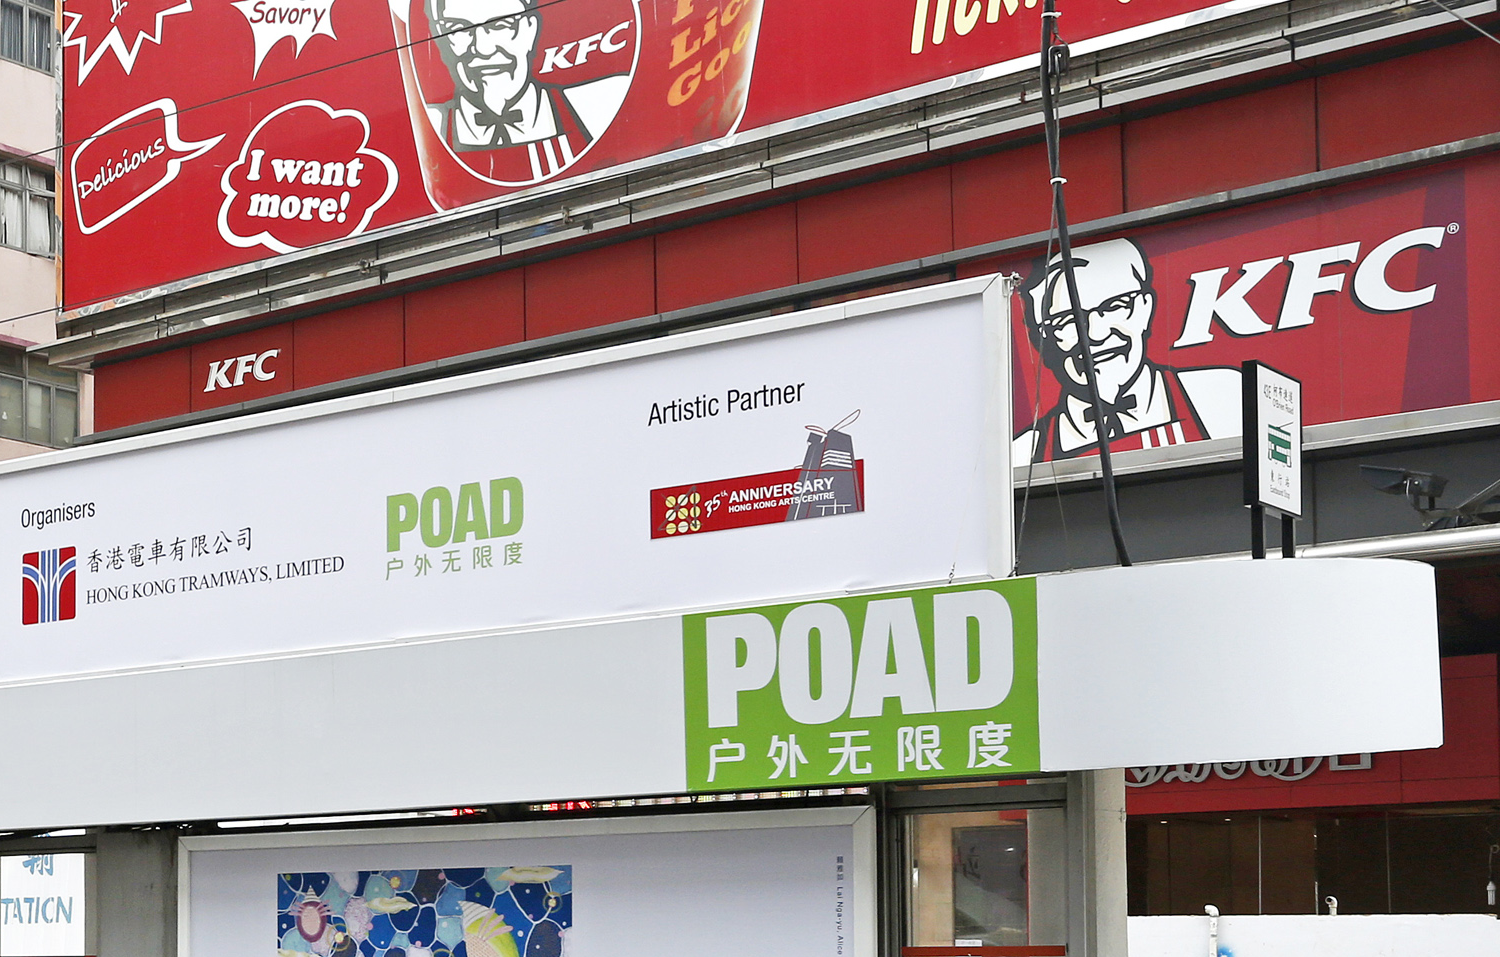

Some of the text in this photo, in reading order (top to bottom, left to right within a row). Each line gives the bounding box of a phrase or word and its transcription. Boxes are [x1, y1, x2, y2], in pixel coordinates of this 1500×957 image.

[250, 1, 327, 33] Savory
[669, 0, 750, 70] Lic
[538, 20, 632, 74] KFC
[78, 138, 166, 199] Delicious
[246, 149, 364, 188] I want
[247, 191, 351, 224] more!
[1173, 226, 1446, 350] KFC
[203, 349, 279, 393] KFC
[647, 382, 806, 427] Artistic Partner
[728, 476, 835, 504] ANNIVERSARY
[728, 491, 836, 514] HONG KONG ARTS CENTRE
[21, 501, 96, 531] Organisers
[385, 475, 525, 553] POAD
[86, 527, 254, 574] 香港電車有限公司
[86, 555, 345, 605] HONG KONG TRAMWAYS, LIMITED
[705, 589, 1014, 730] POAD
[706, 720, 1013, 783] 户外无限度
[836, 886, 844, 899] Lai
[836, 935, 844, 956] Alice
